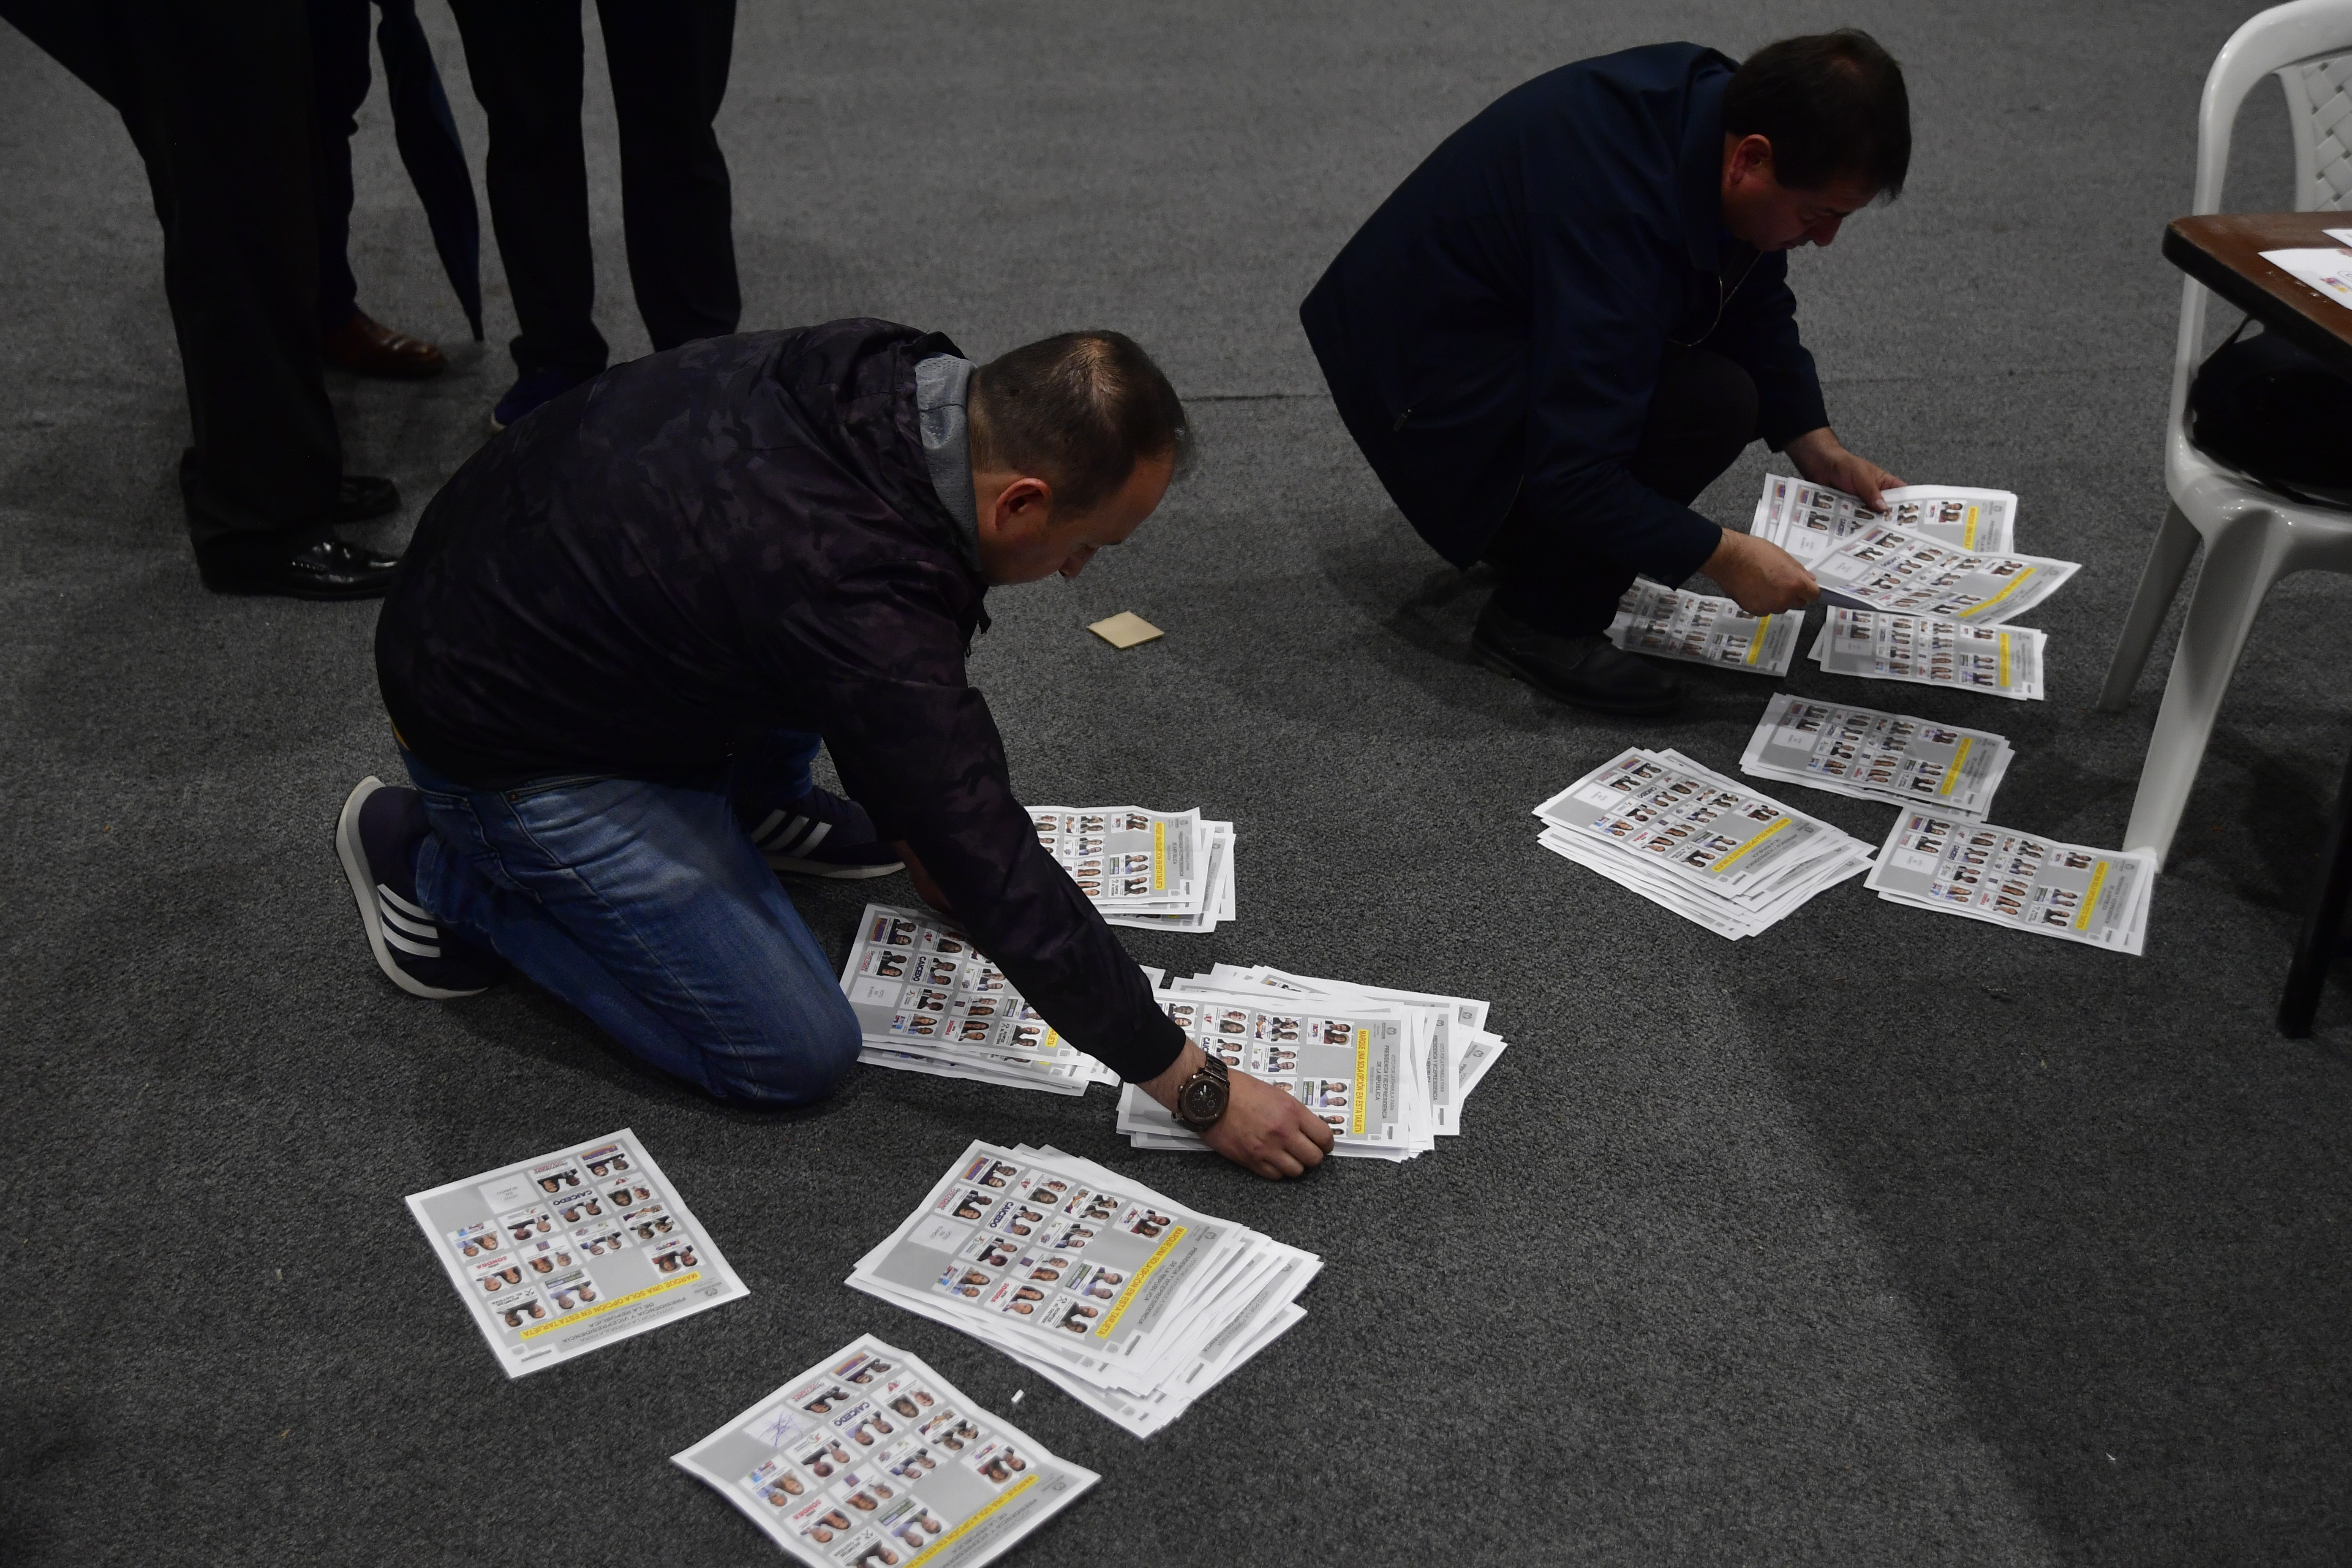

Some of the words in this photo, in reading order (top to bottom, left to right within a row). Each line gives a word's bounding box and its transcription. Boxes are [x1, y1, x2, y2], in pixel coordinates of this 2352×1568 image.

[912, 956, 927, 982] CAICEDO
[1046, 1028, 1056, 1045] ARJETA
[1202, 1037, 1210, 1053] CAIC
[1356, 1073, 1365, 1091] OPCIÓN
[1355, 1100, 1363, 1113] ESTA
[1353, 1114, 1362, 1132] TARJETA
[551, 1189, 594, 1206] CAICEDO
[986, 1200, 1016, 1229] CAICEDO
[1162, 1227, 1184, 1247] MARQUE
[1154, 1246, 1168, 1257] UNA
[475, 1255, 508, 1269] SONDRA
[1145, 1255, 1160, 1269] SOLA
[1171, 1247, 1198, 1275] PRESIDENCIA
[1186, 1257, 1198, 1268] VOTO
[663, 1272, 698, 1288] MARQUE
[1129, 1267, 1151, 1288] OPCIÓN
[1179, 1268, 1189, 1277] POR
[646, 1284, 664, 1294] UNA
[989, 1282, 1010, 1303] SONDRA
[1124, 1288, 1135, 1296] EN
[1141, 1273, 1168, 1301] REPÚBLICA
[623, 1290, 647, 1301] SOLA
[1136, 1278, 1171, 1325] VICEPRESIDENCIA
[592, 1297, 625, 1313] OPCIÓN
[636, 1296, 686, 1316] PRESIDENCIA
[655, 1306, 675, 1315] VOTO
[1113, 1296, 1130, 1312] ESTA
[1151, 1303, 1164, 1317] PARA
[558, 1313, 580, 1325] ESTA
[580, 1309, 593, 1317] EN
[588, 1309, 632, 1328] REPÚBLICA
[522, 1320, 558, 1337] TARJETA
[561, 1316, 630, 1343] VICEPRESIDENCIA
[1096, 1310, 1121, 1335] TARJETA
[831, 1401, 872, 1427] CAICEDO
[1004, 1475, 1036, 1497] MARQUE
[990, 1495, 1007, 1508] UNA
[972, 1506, 992, 1521] SOLA
[934, 1538, 947, 1548] EN
[915, 1546, 937, 1562] ESTA
